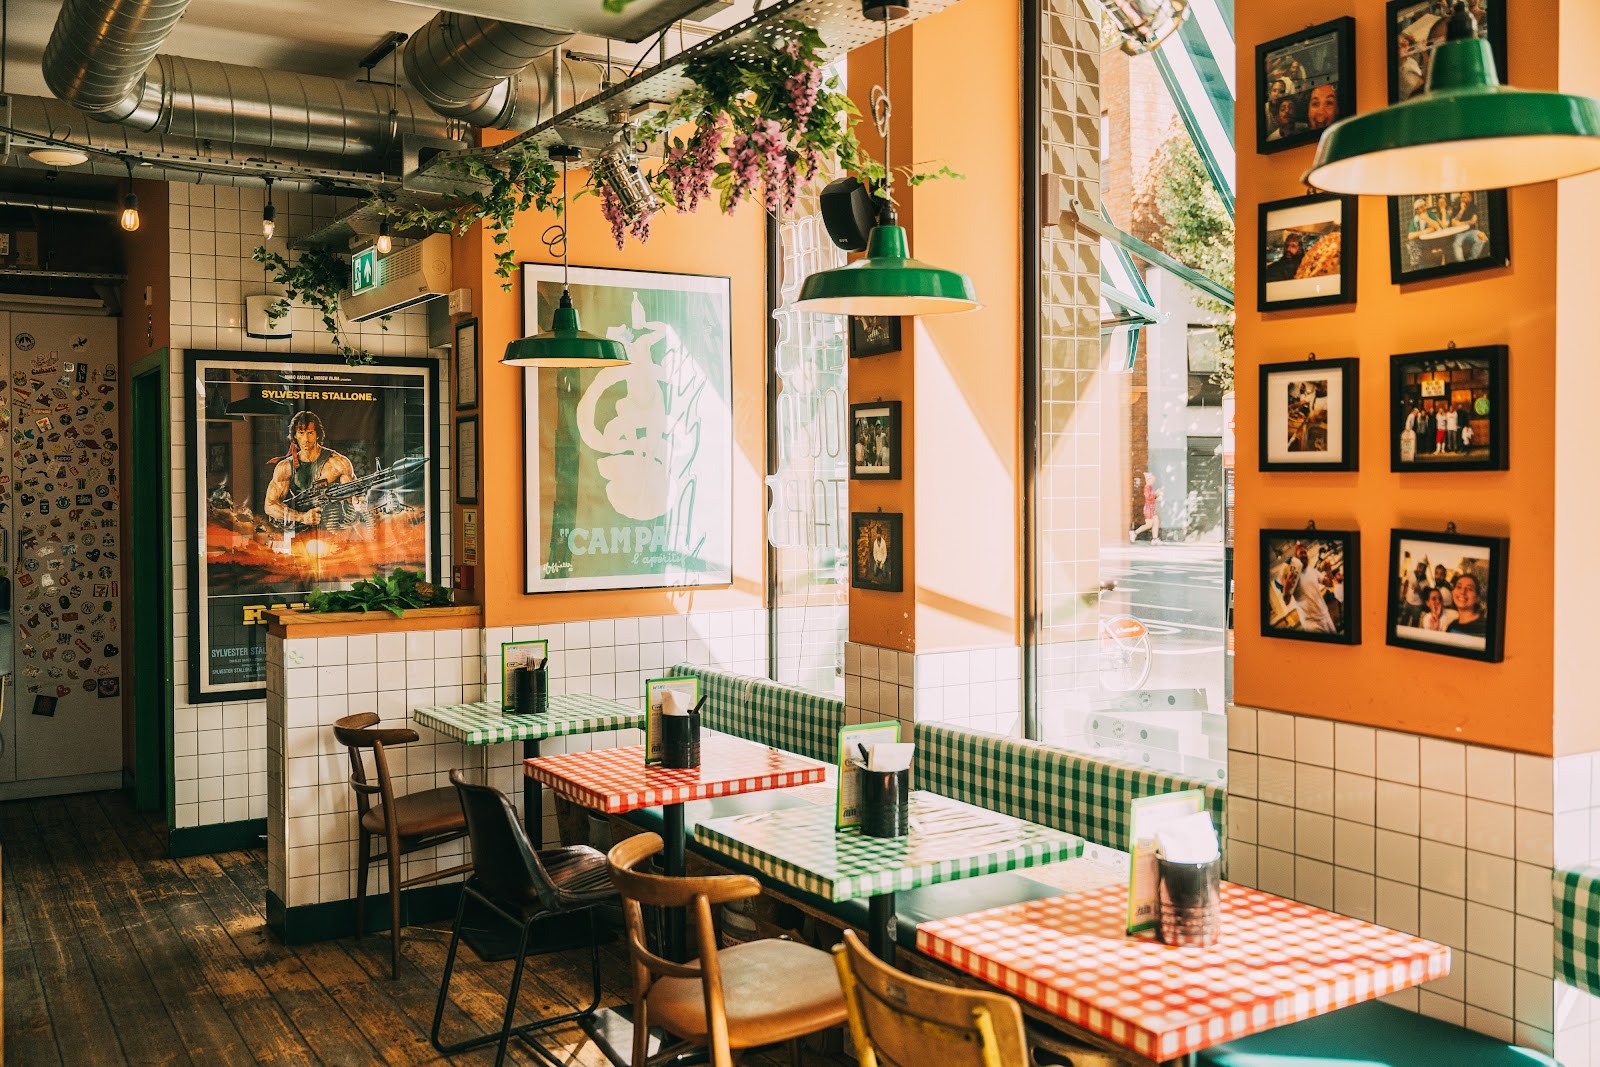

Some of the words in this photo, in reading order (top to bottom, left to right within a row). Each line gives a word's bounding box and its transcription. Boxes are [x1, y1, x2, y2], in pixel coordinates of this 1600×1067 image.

[262, 389, 320, 399] SYLVESTER
[322, 391, 372, 401] STALLONE
[212, 647, 249, 657] SYLVESTER
[250, 646, 266, 655] STAL
